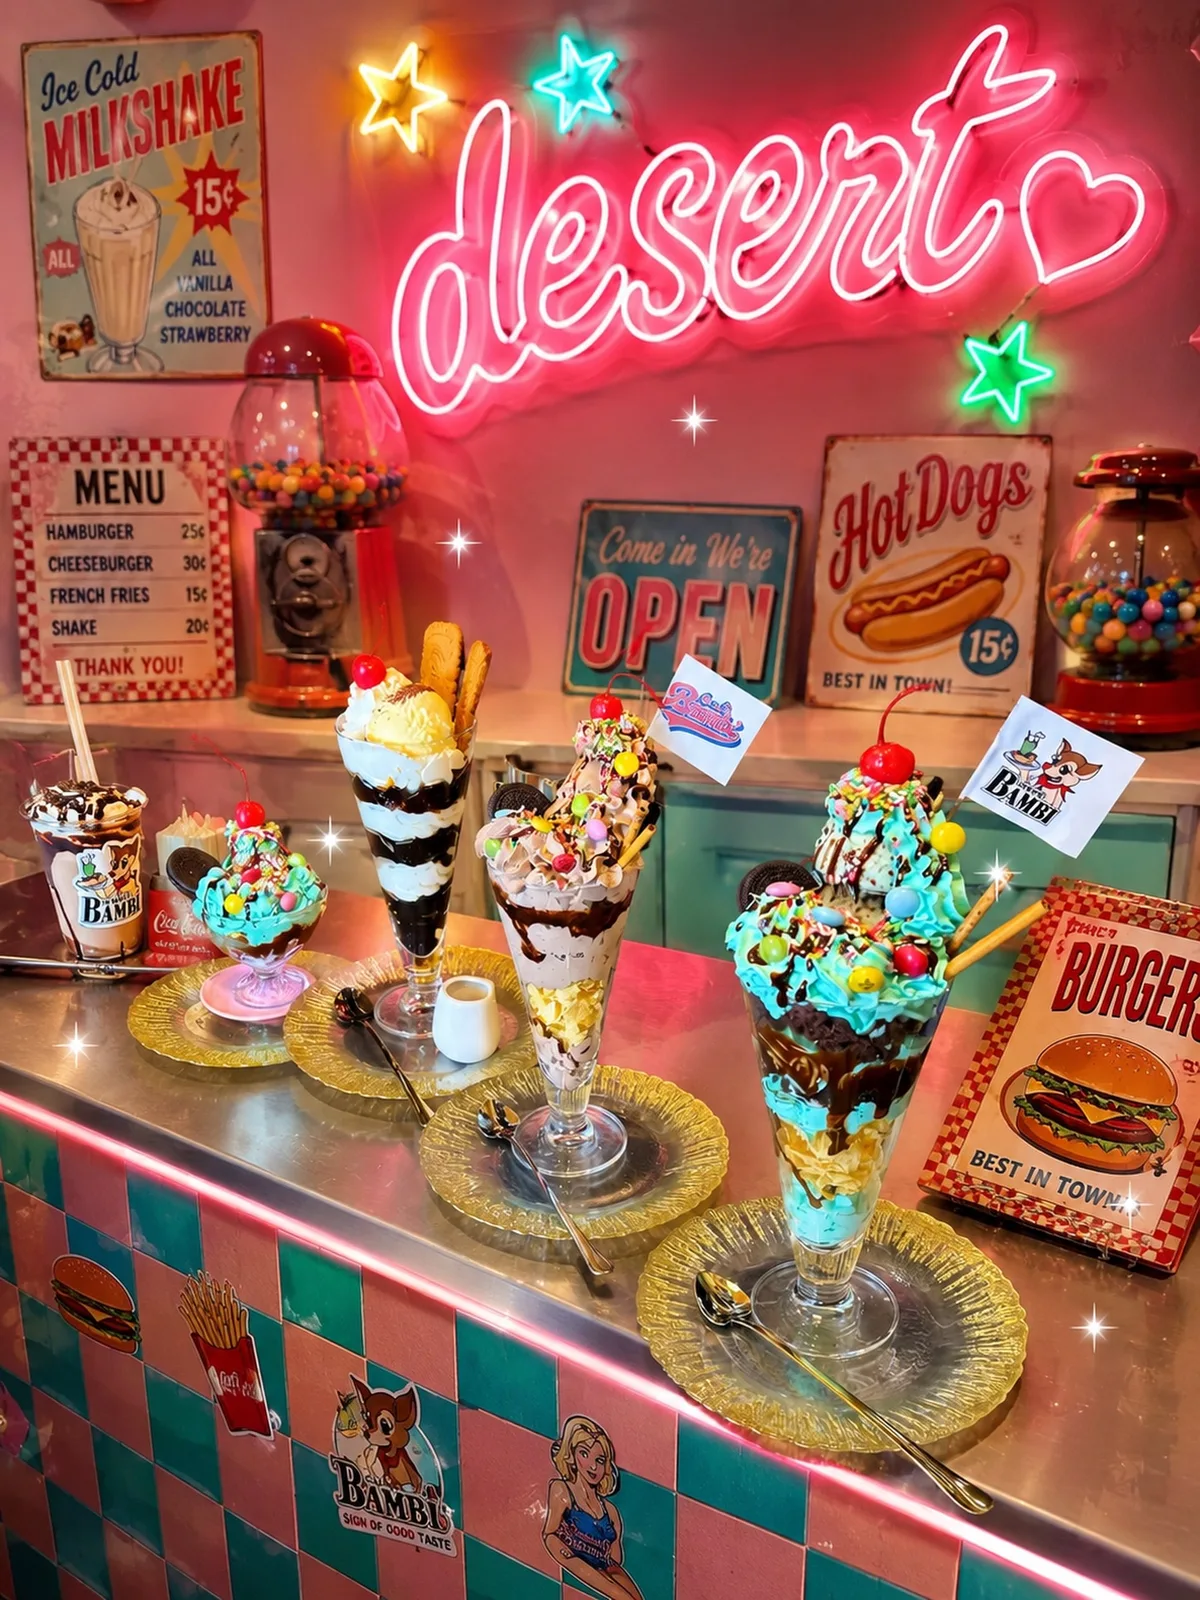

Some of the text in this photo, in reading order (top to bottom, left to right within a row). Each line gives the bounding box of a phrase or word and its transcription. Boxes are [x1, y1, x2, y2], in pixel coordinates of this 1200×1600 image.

[41, 52, 140, 112] Ice Cold
[43, 57, 245, 186] MILKSHAKE
[194, 177, 234, 216] 15¢
[392, 24, 1057, 415] desert
[48, 247, 75, 269] ALL
[192, 250, 217, 267] ALL
[176, 275, 233, 293] VANILLA
[165, 300, 246, 319] CHOCOLATE
[160, 326, 252, 344] STRAWBERRY
[74, 469, 165, 505] MENU
[46, 524, 205, 541] HAMBURGER 25¢
[828, 453, 1033, 590] Hot Dogs
[599, 525, 773, 570] Come in We're
[48, 556, 206, 572] CHEESEBURGER 30¢
[50, 587, 208, 604] FRENCH FRIES 15¢
[52, 618, 209, 636] SHAKE 20¢
[578, 572, 777, 681] OPEN
[968, 628, 1014, 664] 15¢
[74, 656, 184, 676] THANK YOU!
[822, 671, 953, 694] BEST IN TOWN!
[984, 767, 1060, 826] BAMBI
[83, 893, 141, 923] BAMBI
[970, 1150, 1023, 1178] BEST
[1024, 1166, 1052, 1189] IN
[370, 1521, 383, 1532] OF
[417, 1532, 452, 1551] TASTE
